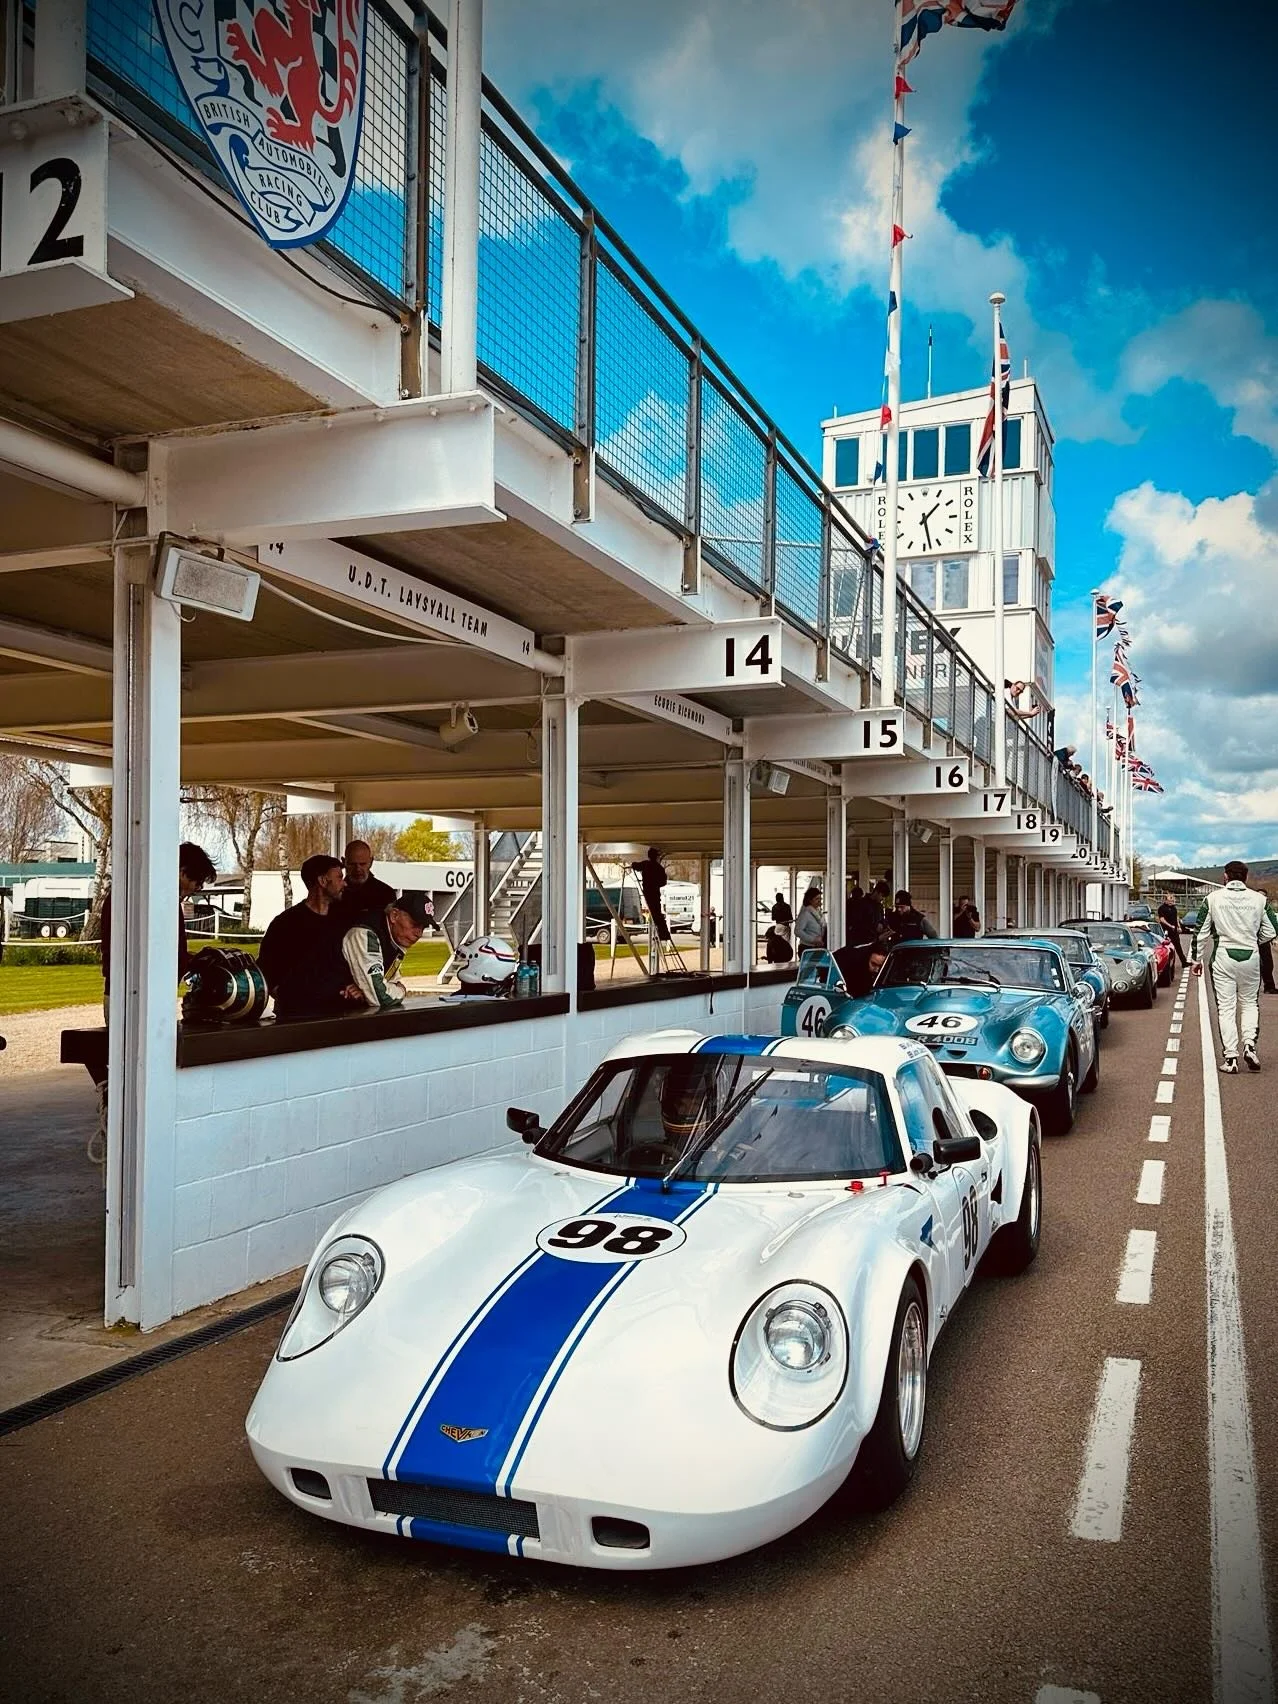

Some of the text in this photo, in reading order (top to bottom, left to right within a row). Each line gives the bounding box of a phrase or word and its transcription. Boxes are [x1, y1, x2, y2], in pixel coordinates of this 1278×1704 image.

[203, 103, 250, 128] BRITISH
[258, 137, 331, 199] AUTOMOBILE
[258, 173, 303, 207] RACING
[0, 157, 84, 269] 2
[250, 191, 280, 223] CLUB
[964, 486, 974, 543] ROLEX
[348, 564, 391, 598] U.D.T.
[461, 612, 488, 637] TEAM
[522, 640, 530, 655] 14
[725, 634, 773, 677] 14
[863, 719, 898, 749] 15
[935, 765, 964, 788] 16
[983, 793, 1007, 812] 17
[1016, 813, 1037, 830] 18
[1041, 828, 1060, 843] 19
[802, 1005, 826, 1038] 46
[917, 1015, 963, 1028] 46
[548, 1219, 673, 1255] 98
[962, 1184, 979, 1271] 98
